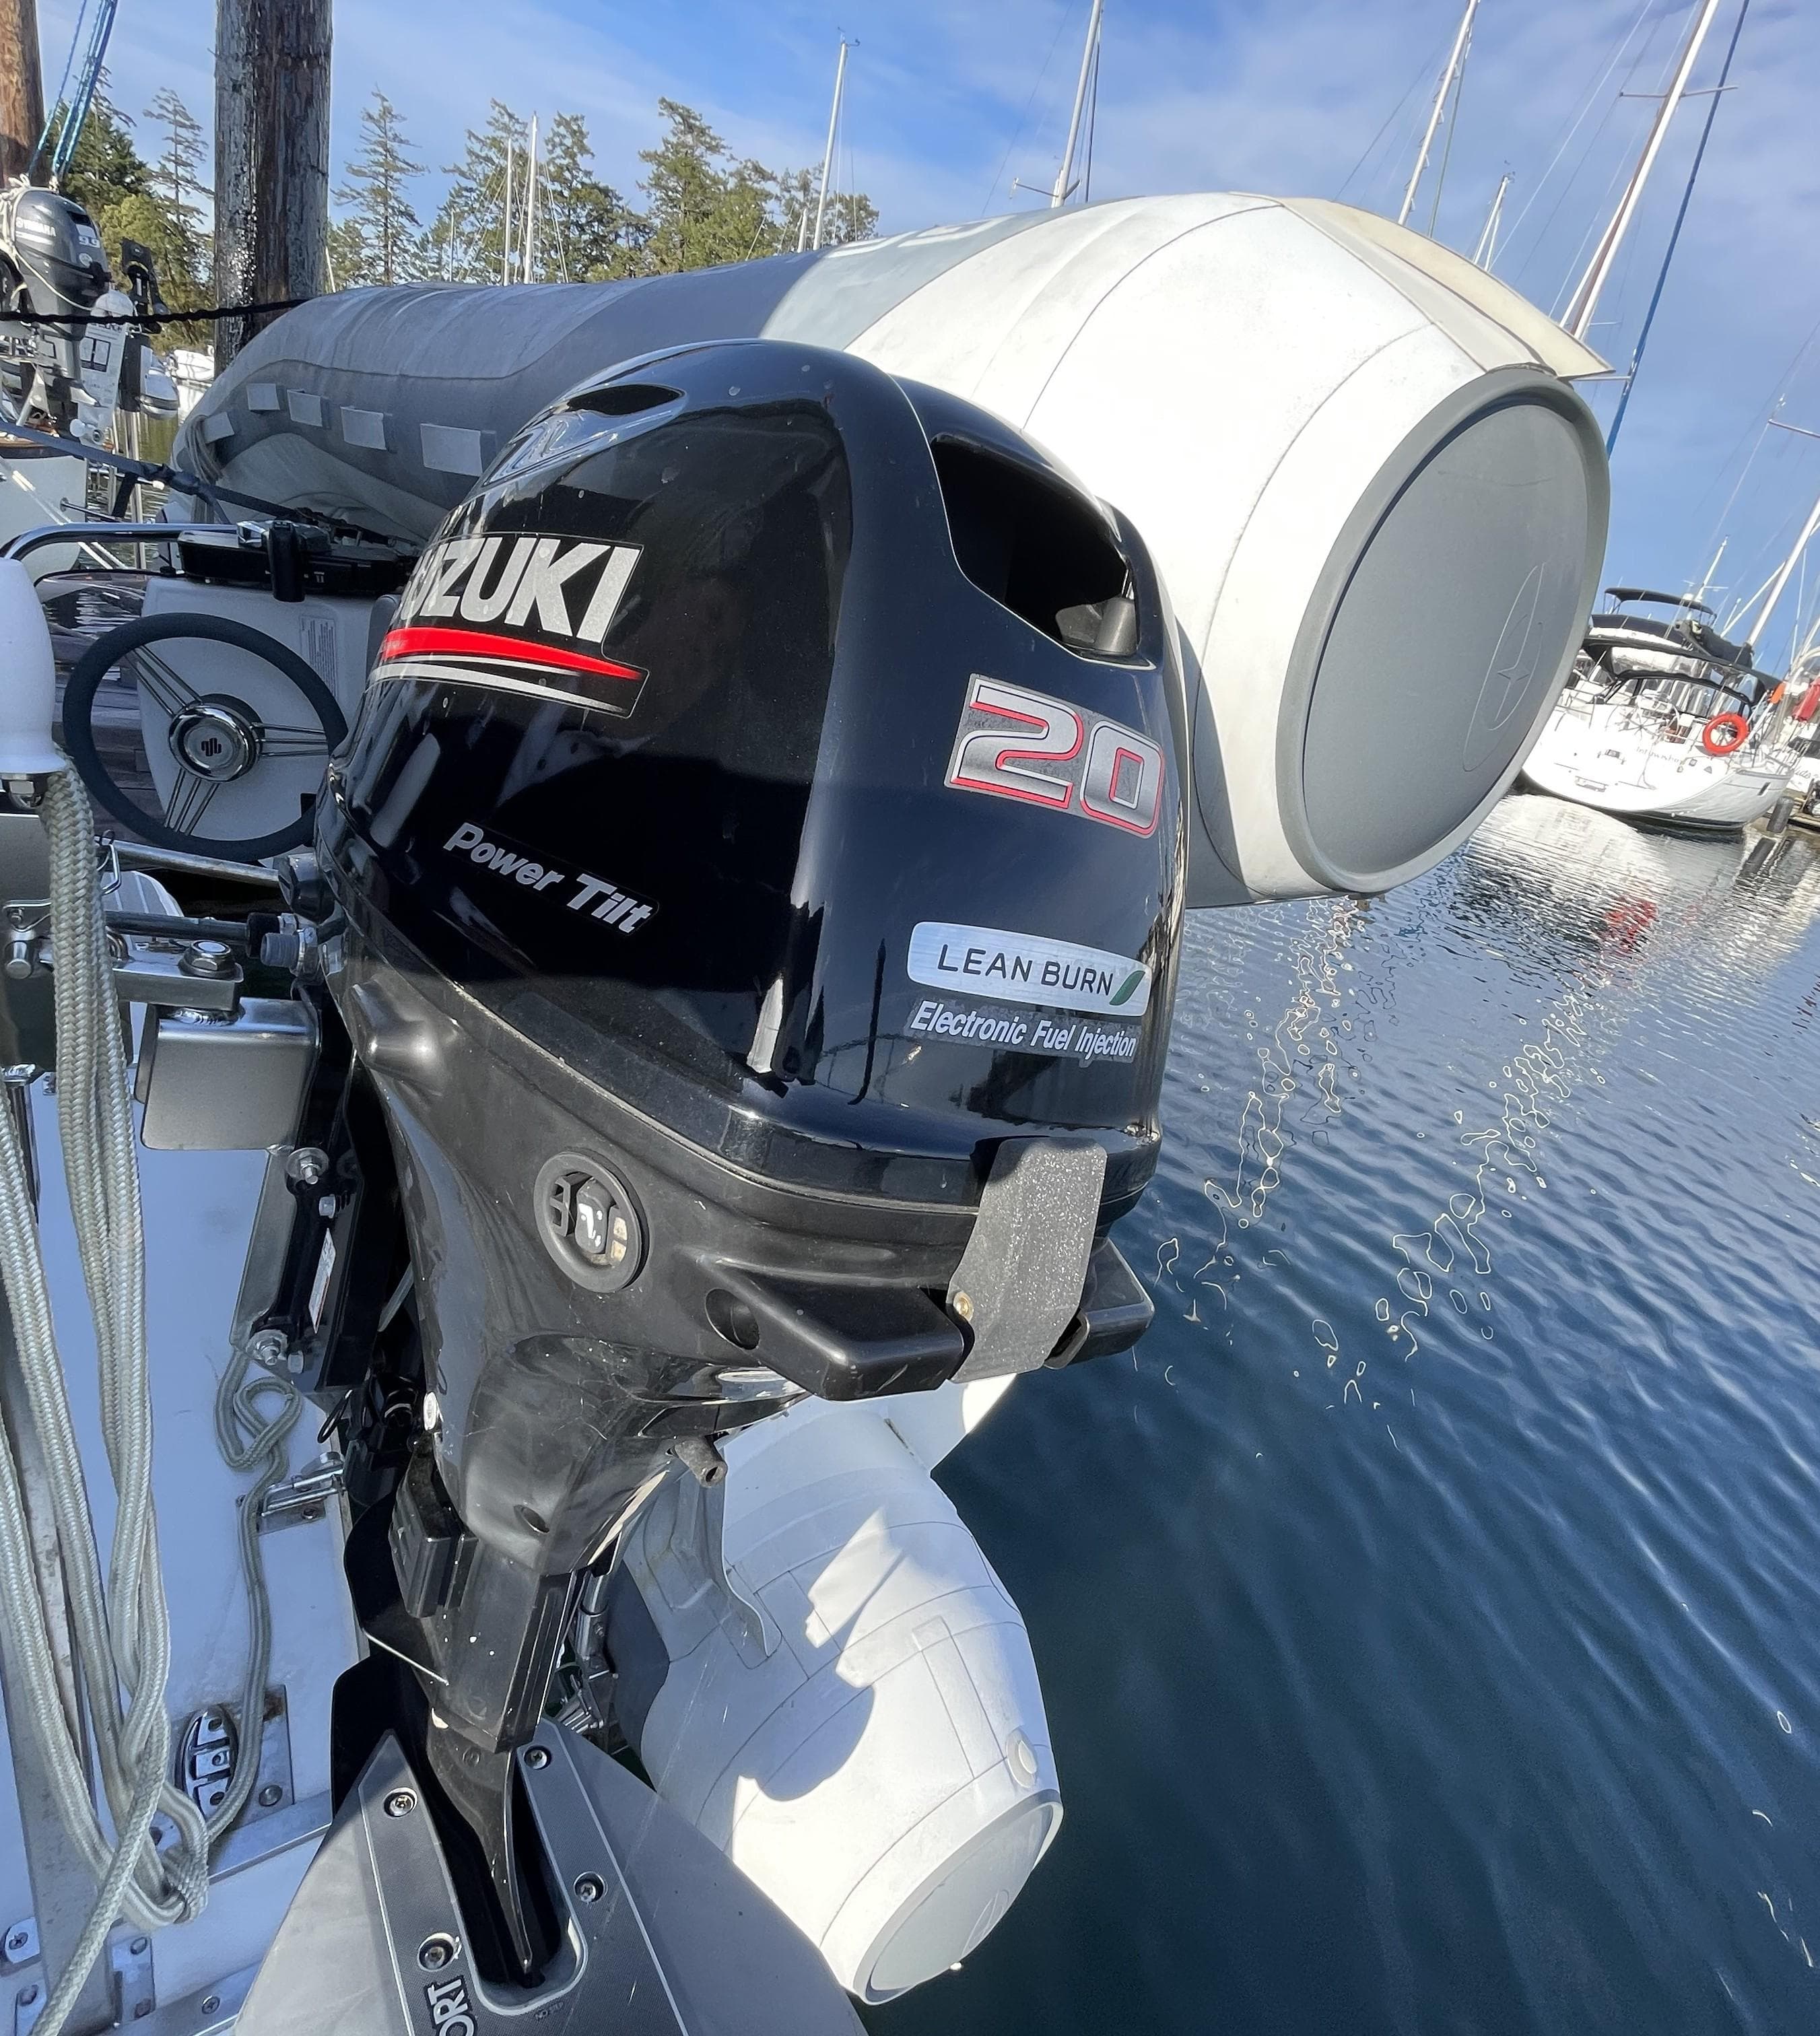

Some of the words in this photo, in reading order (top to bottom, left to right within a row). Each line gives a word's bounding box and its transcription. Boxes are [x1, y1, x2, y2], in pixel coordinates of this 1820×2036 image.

[950, 678, 1166, 836] 20
[443, 822, 565, 891] Power
[566, 873, 652, 933] Tilt
[937, 944, 1032, 982] LEAN
[1041, 961, 1114, 996] BURN
[910, 1000, 1027, 1044] Electronic
[1030, 1019, 1076, 1051] Fuel
[1075, 1025, 1137, 1060] Injection
